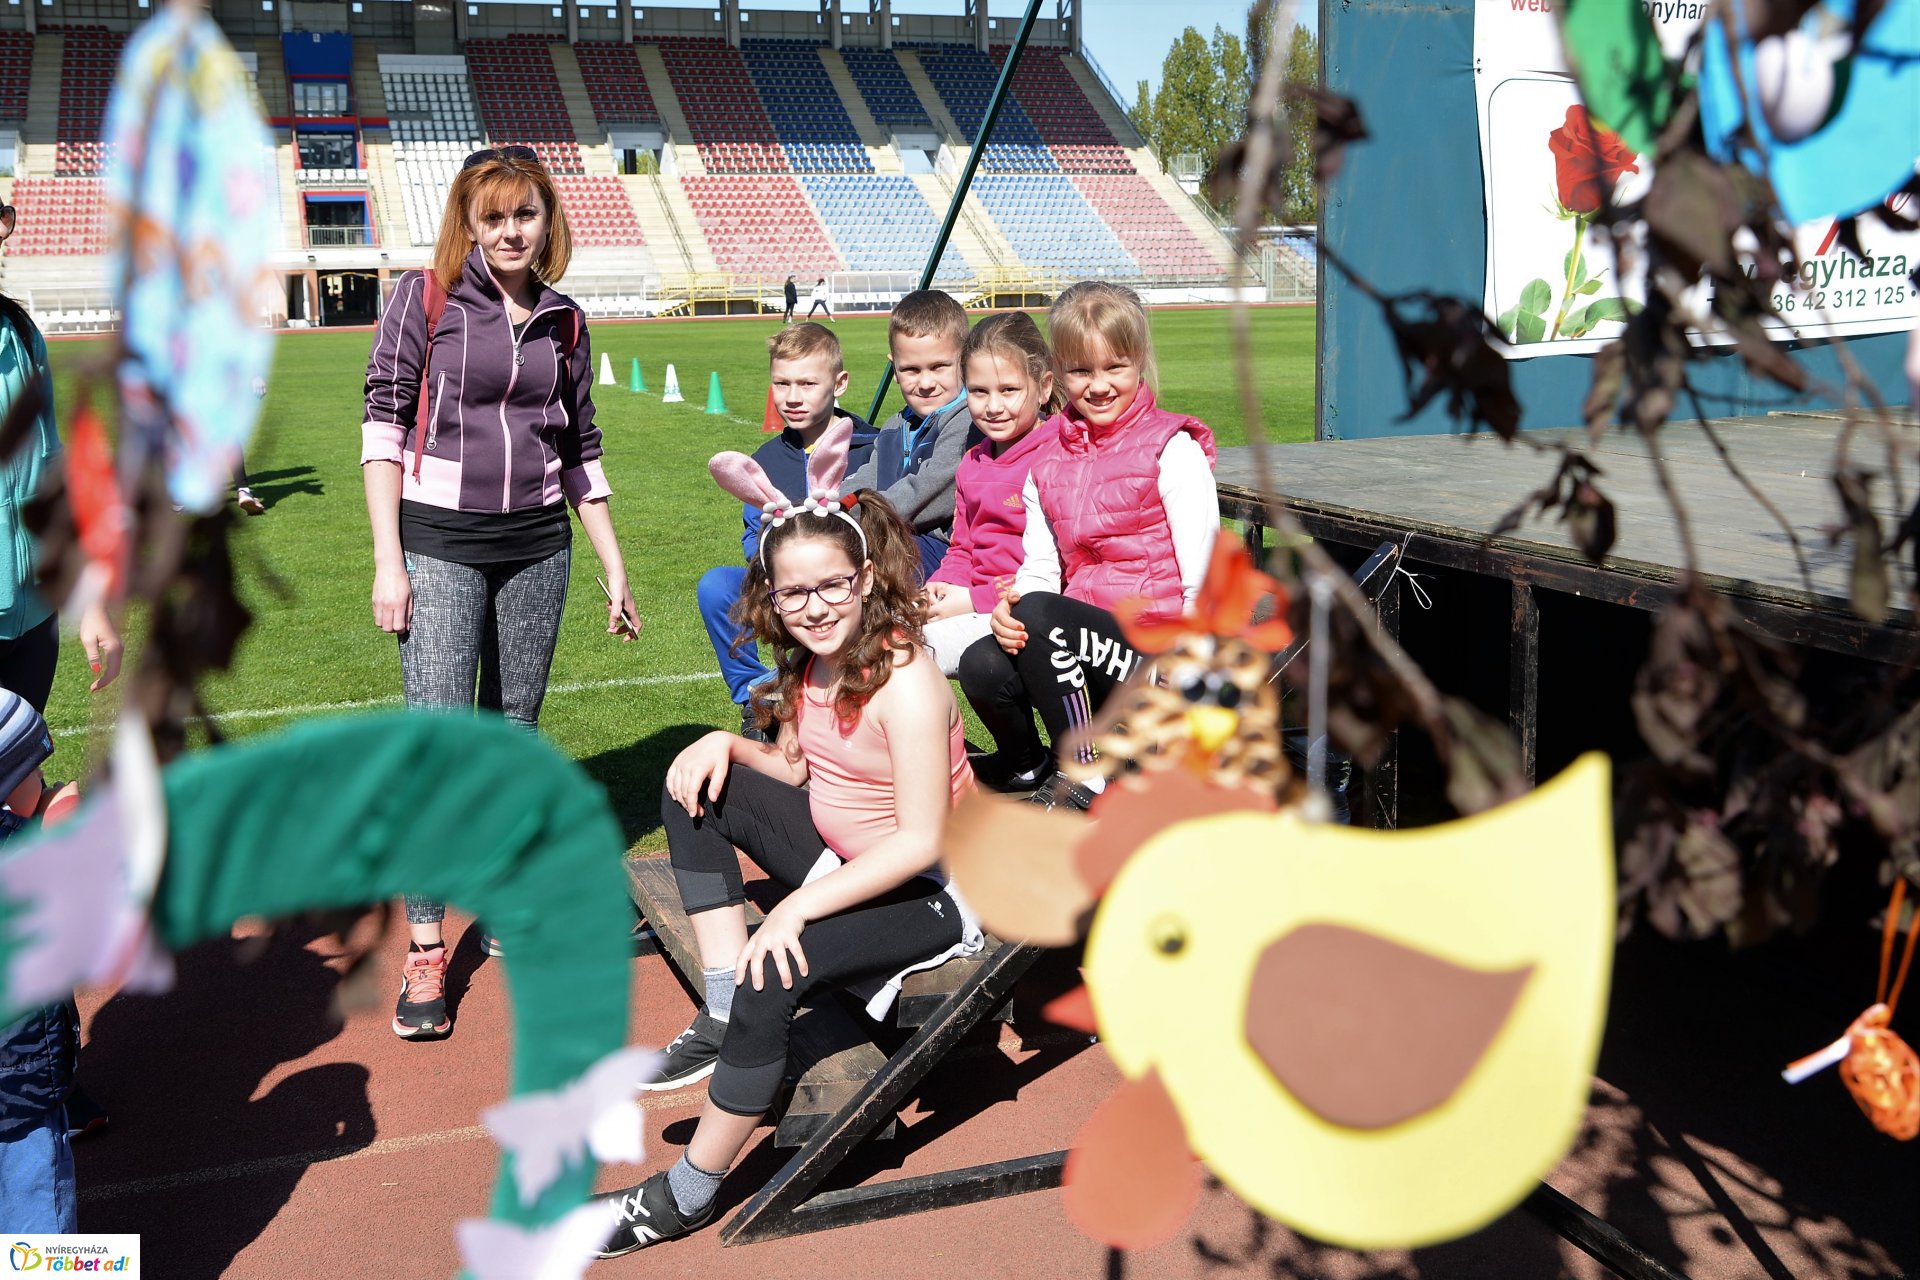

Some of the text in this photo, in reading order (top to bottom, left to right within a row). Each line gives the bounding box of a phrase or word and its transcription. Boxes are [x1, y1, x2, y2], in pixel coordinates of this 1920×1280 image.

[1802, 291, 1826, 311] 42
[1833, 288, 1867, 309] 312
[1875, 286, 1905, 305] 125
[1074, 628, 1142, 684] HAT
